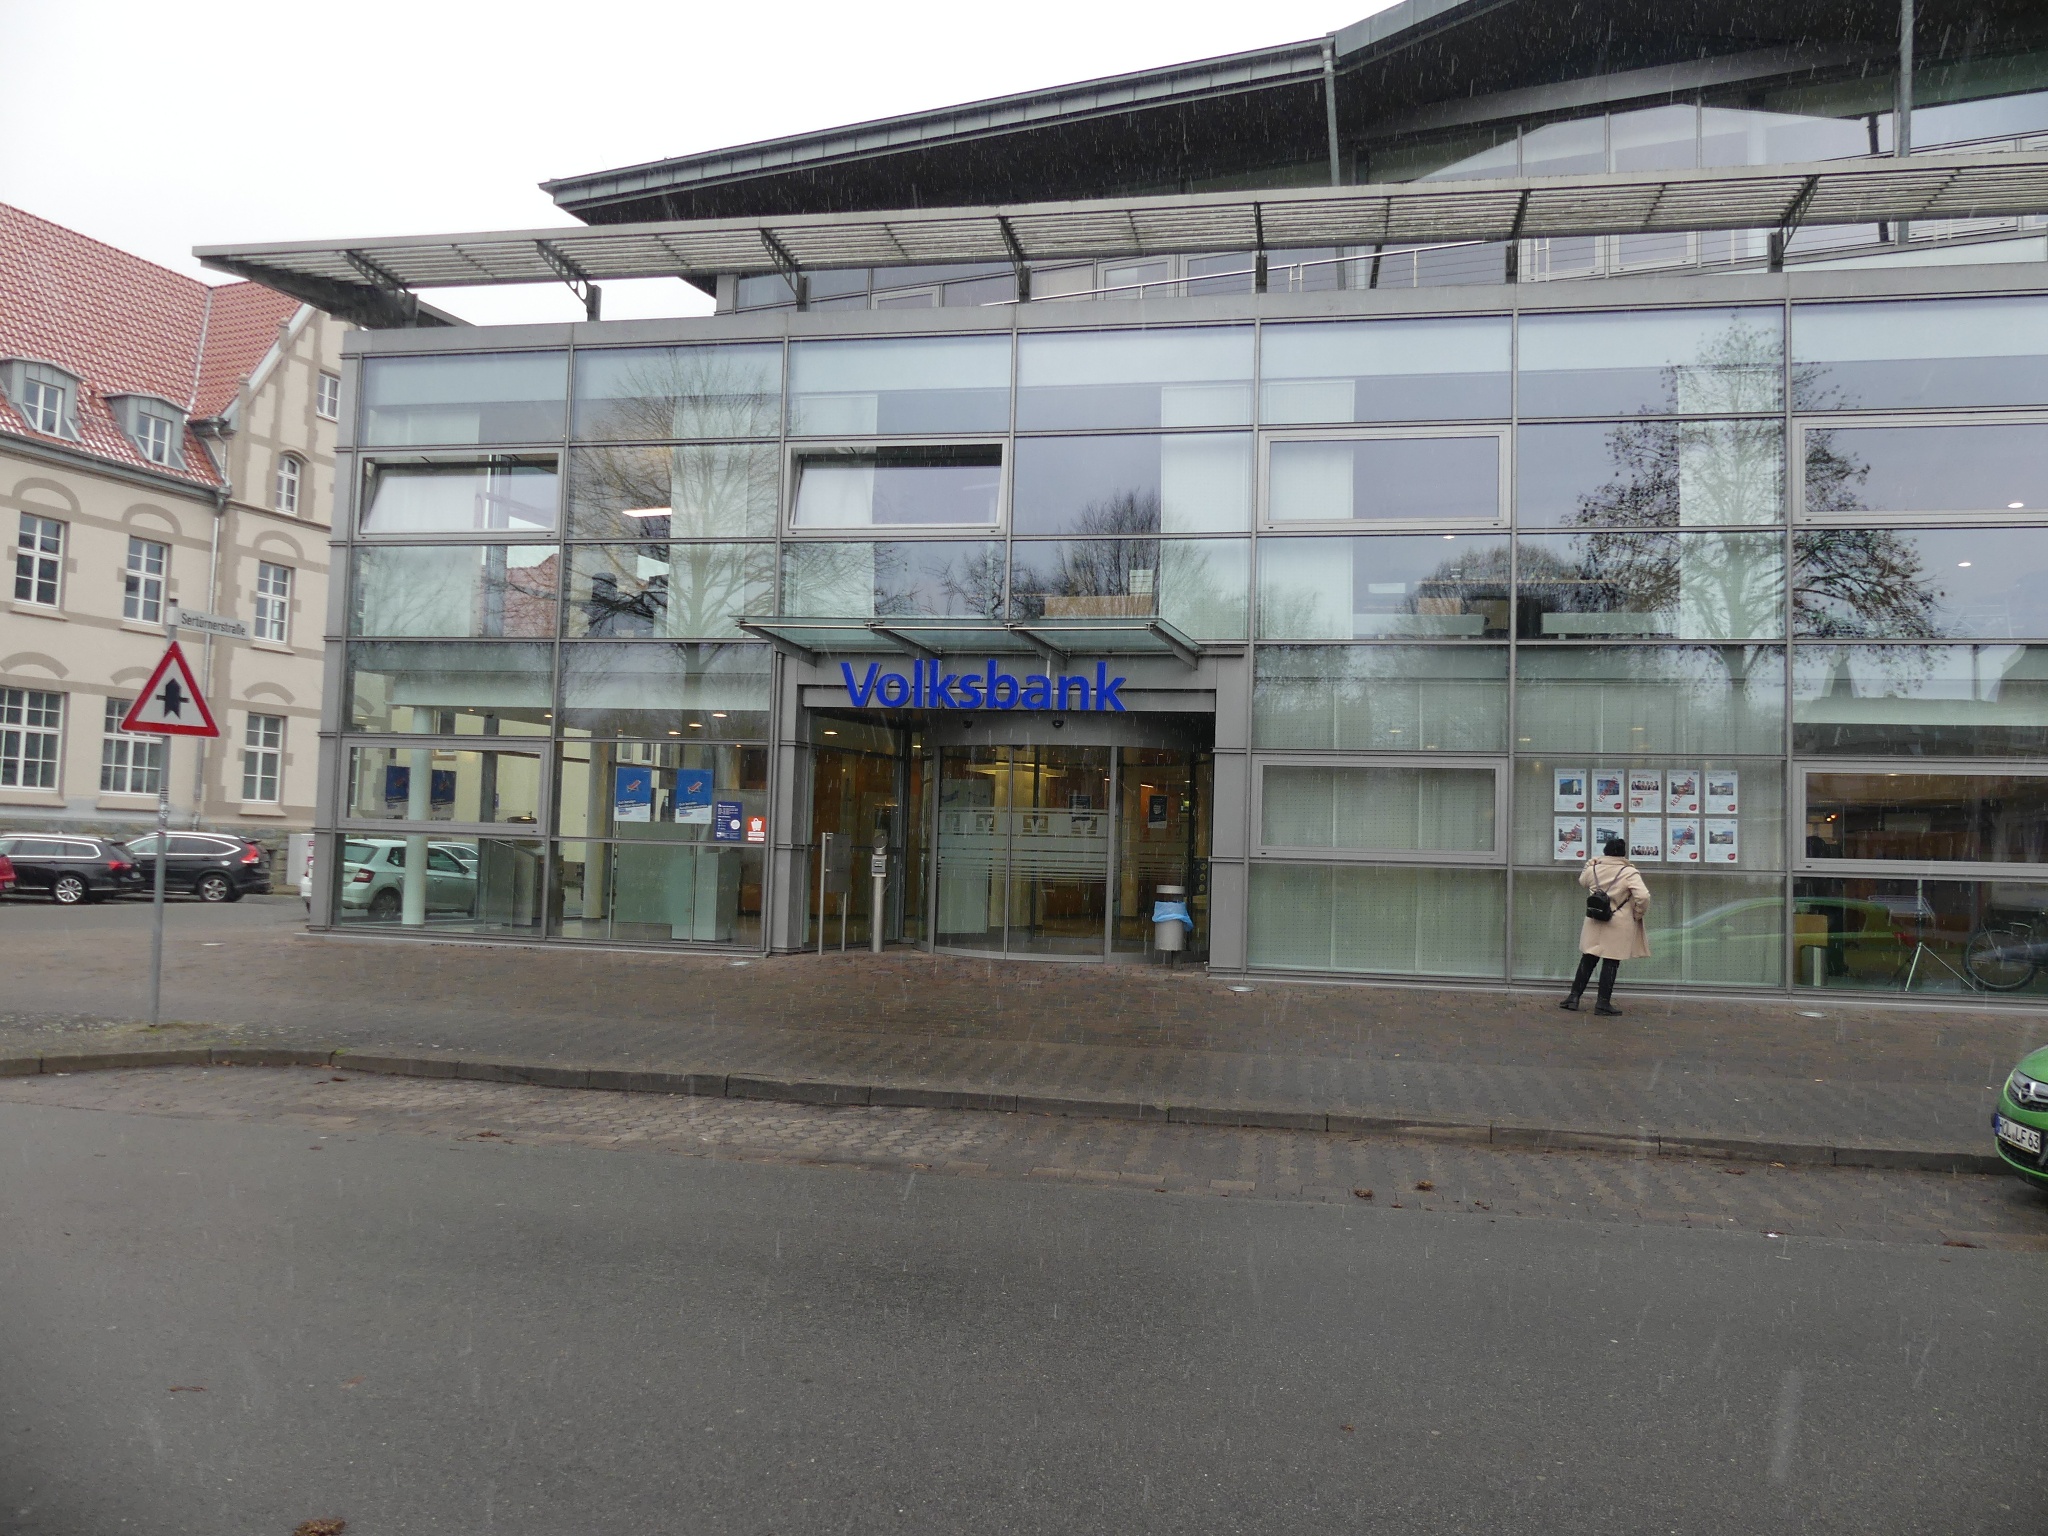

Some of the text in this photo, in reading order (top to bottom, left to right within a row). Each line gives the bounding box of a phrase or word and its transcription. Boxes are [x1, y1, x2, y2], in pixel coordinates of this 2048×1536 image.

[840, 658, 1127, 712] Volksbank
[2015, 1126, 2027, 1144] LF
[2028, 1132, 2039, 1150] 63
